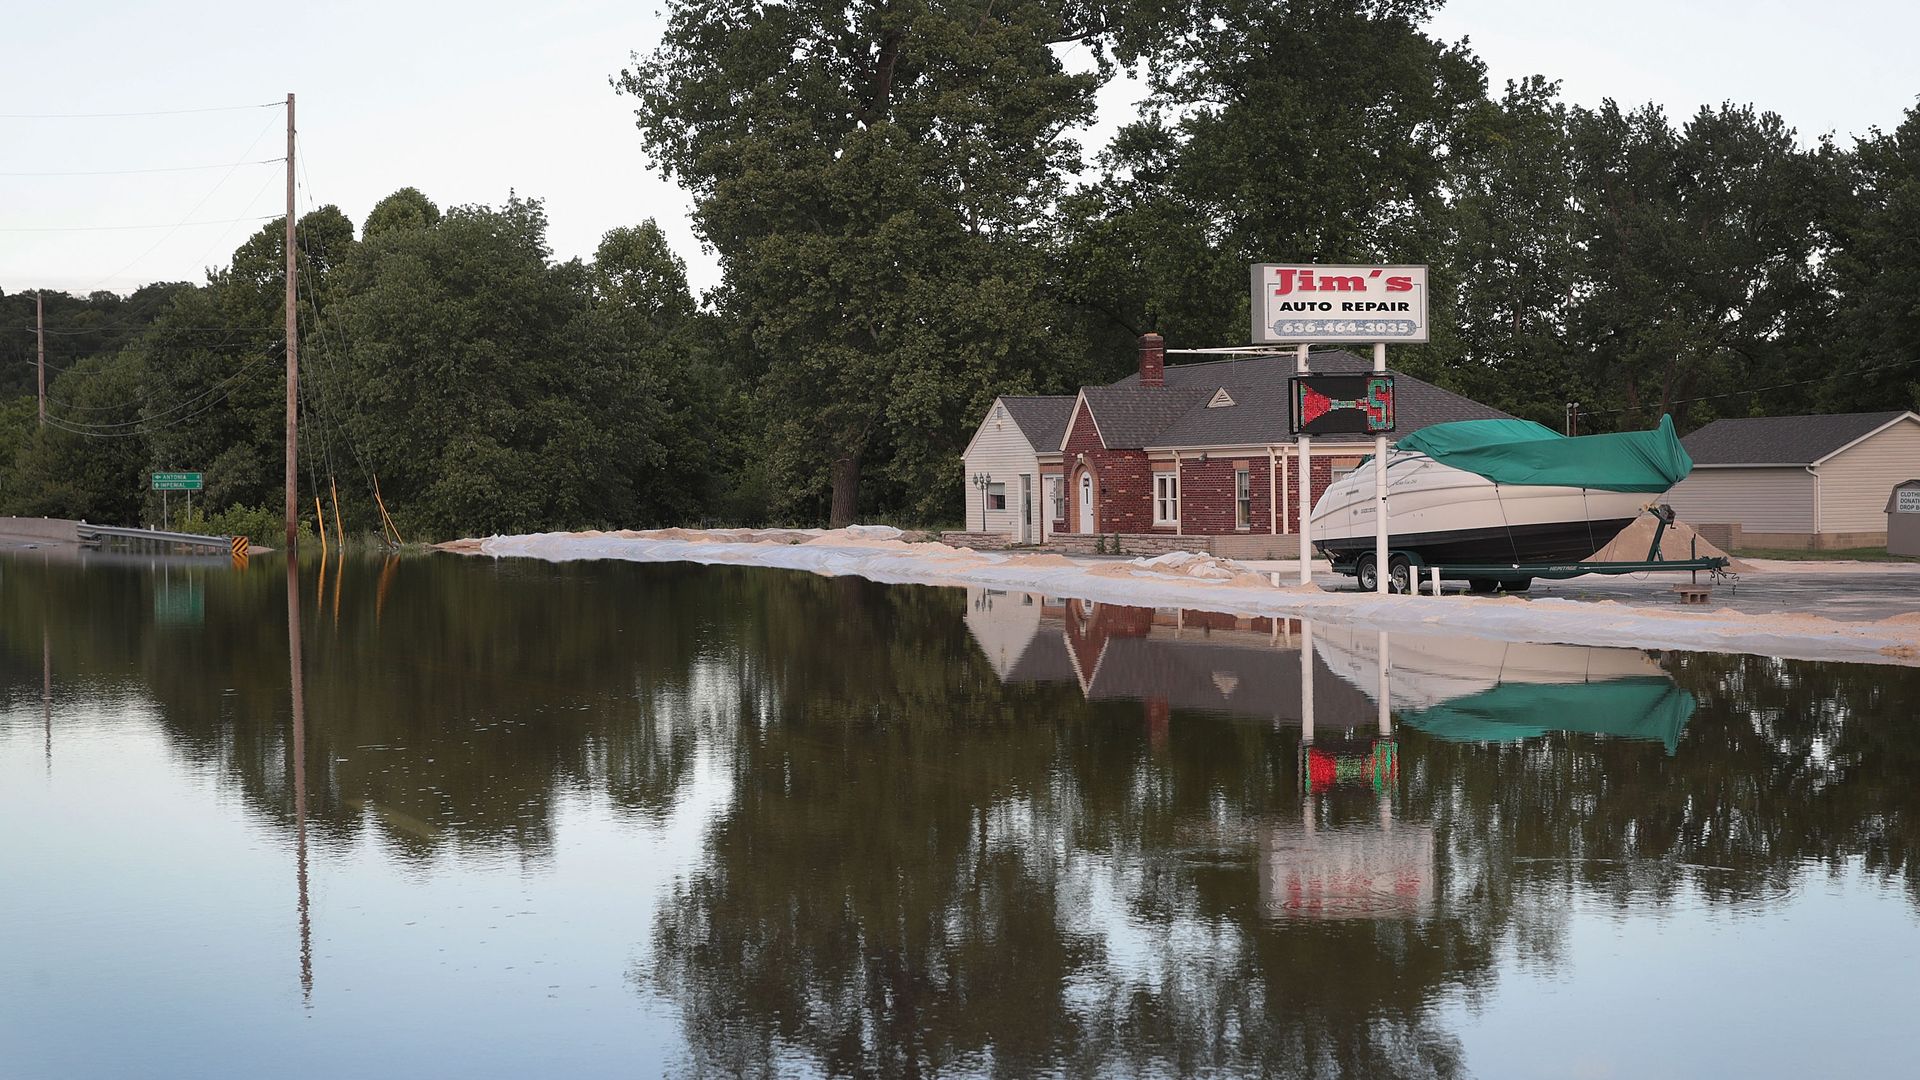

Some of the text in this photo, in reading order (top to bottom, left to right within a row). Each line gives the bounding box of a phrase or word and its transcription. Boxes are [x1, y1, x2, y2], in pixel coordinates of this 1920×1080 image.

[1274, 269, 1414, 296] Jim's
[1279, 301, 1410, 312] AUTO REPAIR
[1282, 322, 1409, 333] 636-464-3035
